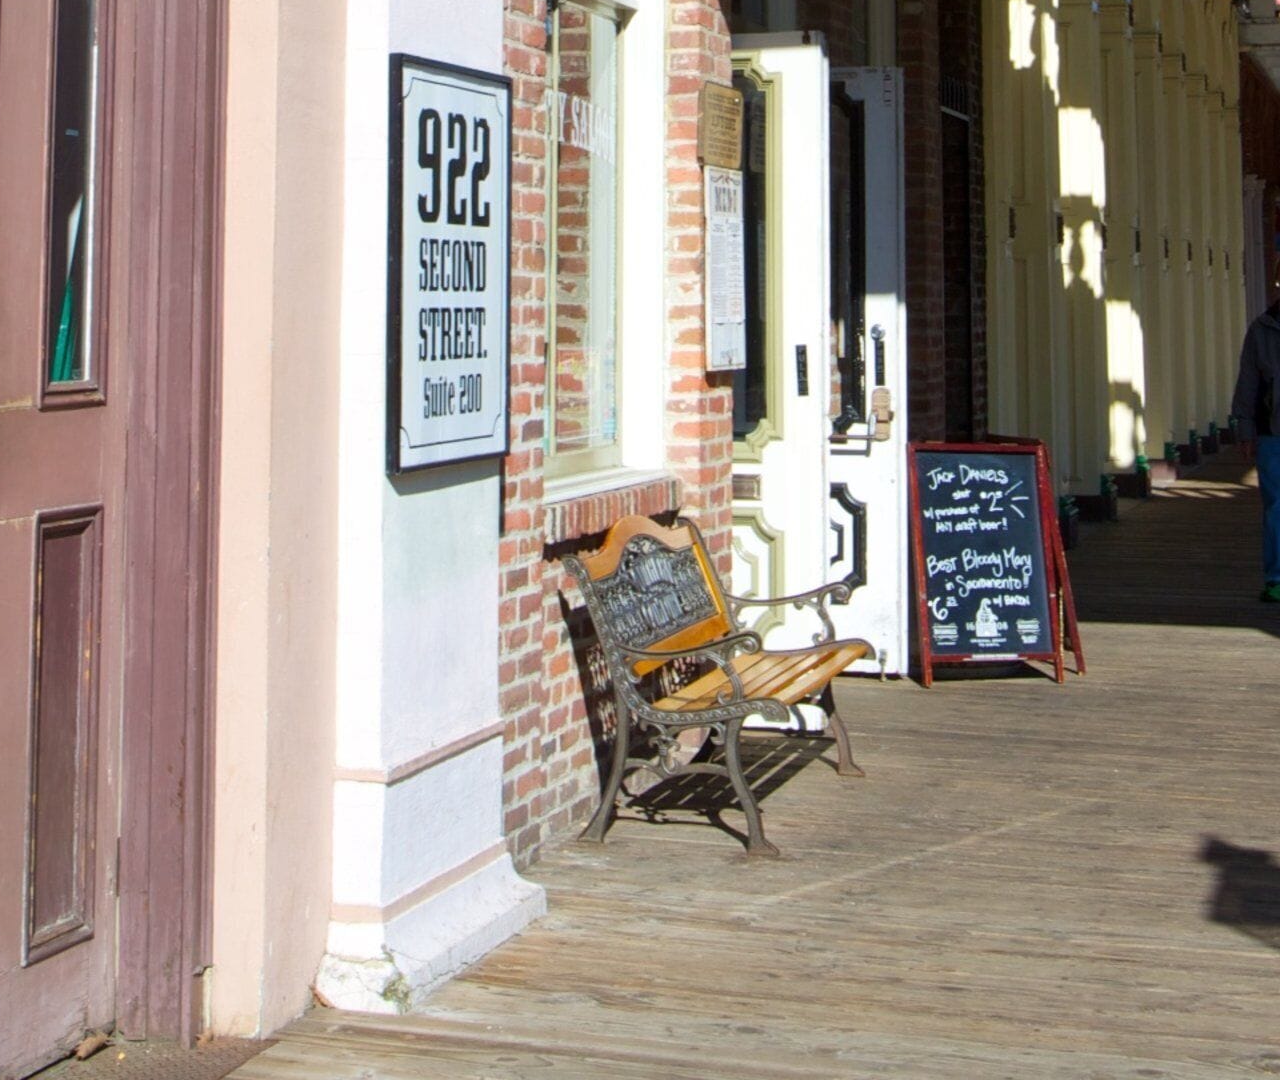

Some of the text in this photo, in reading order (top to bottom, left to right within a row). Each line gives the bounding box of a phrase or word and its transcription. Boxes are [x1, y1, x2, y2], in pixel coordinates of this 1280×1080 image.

[418, 108, 490, 227] 922
[419, 239, 486, 292] SECOND
[419, 308, 488, 361] STREET.
[424, 373, 483, 418] Suite 200
[961, 548, 1003, 577] Bloody
[1003, 546, 1033, 576] Mary
